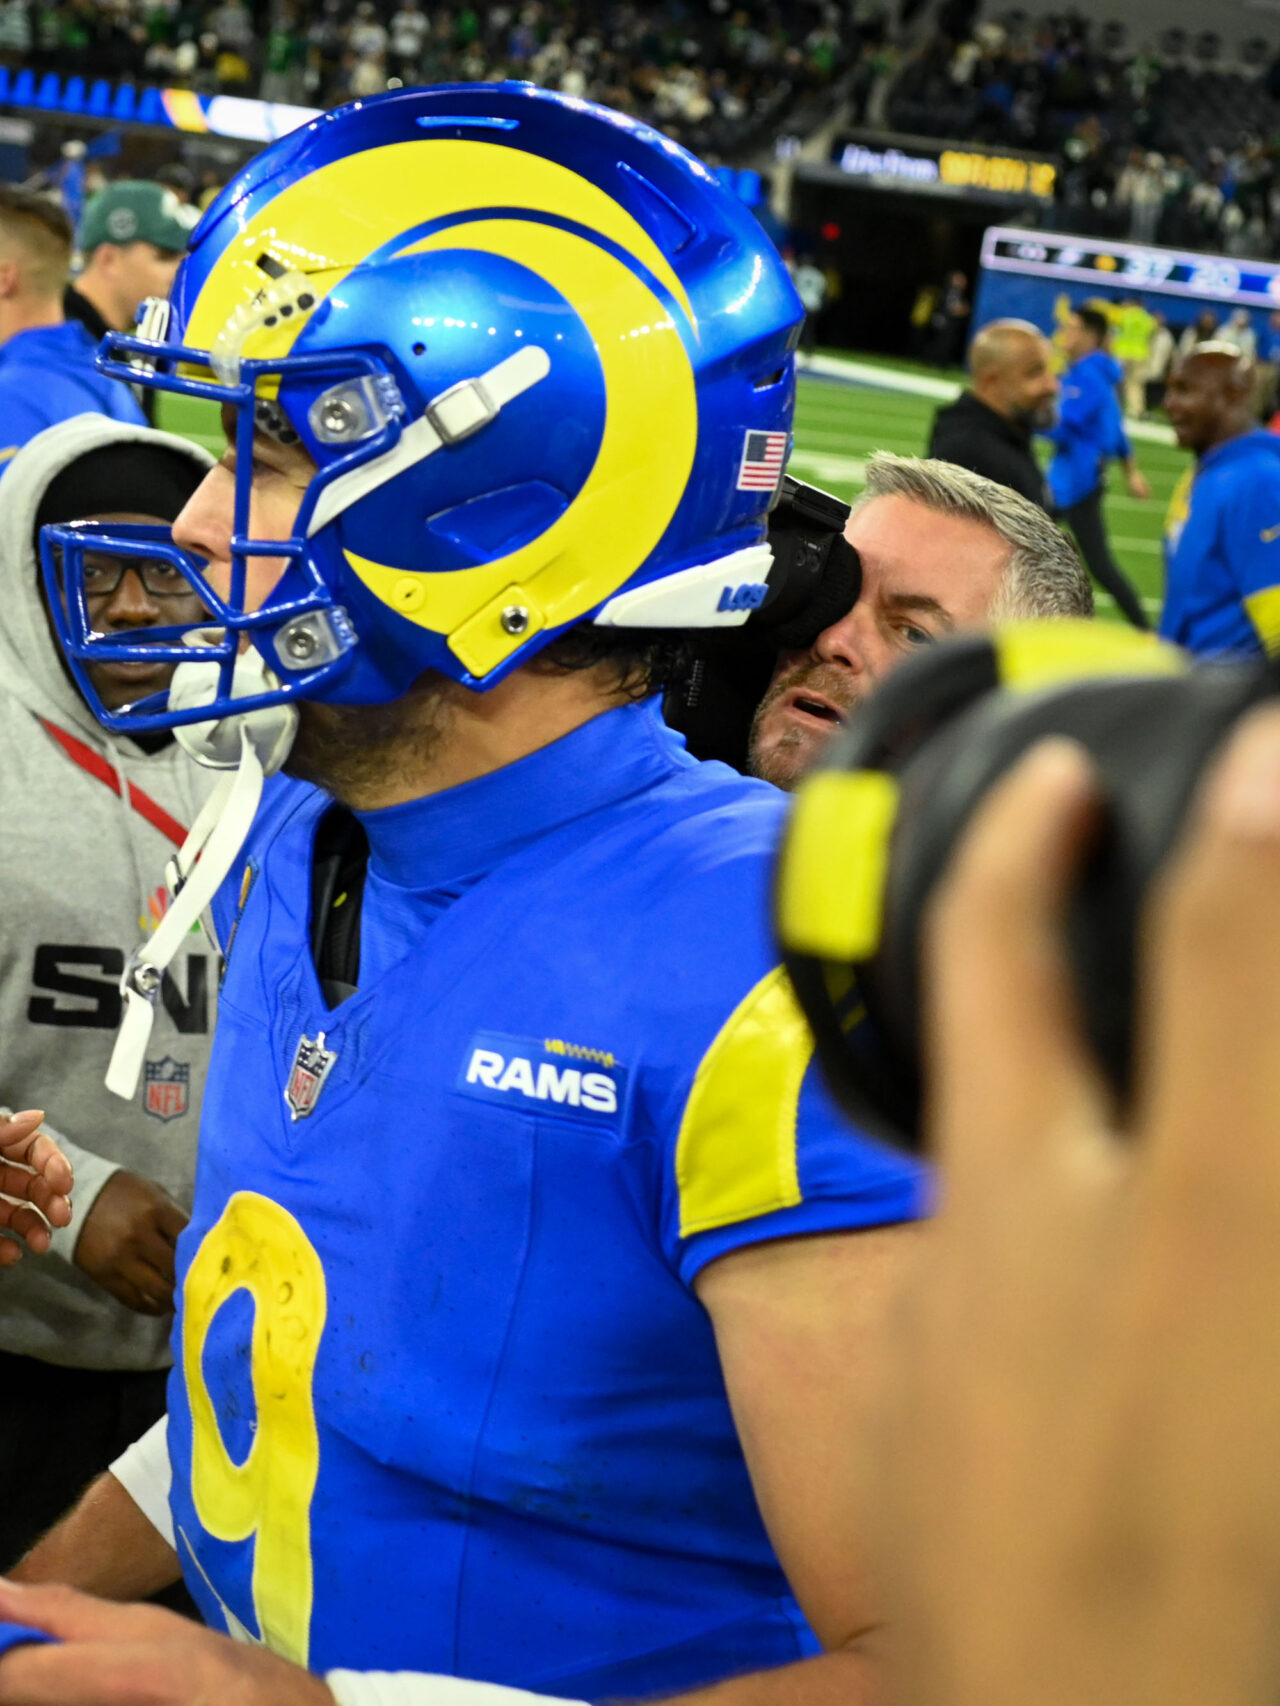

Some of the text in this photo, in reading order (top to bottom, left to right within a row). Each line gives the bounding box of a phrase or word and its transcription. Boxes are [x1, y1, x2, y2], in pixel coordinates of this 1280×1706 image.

[27, 943, 226, 1035] SN
[147, 1083, 186, 1115] NFL
[466, 1048, 618, 1114] RAMS
[182, 1189, 328, 1674] 9
